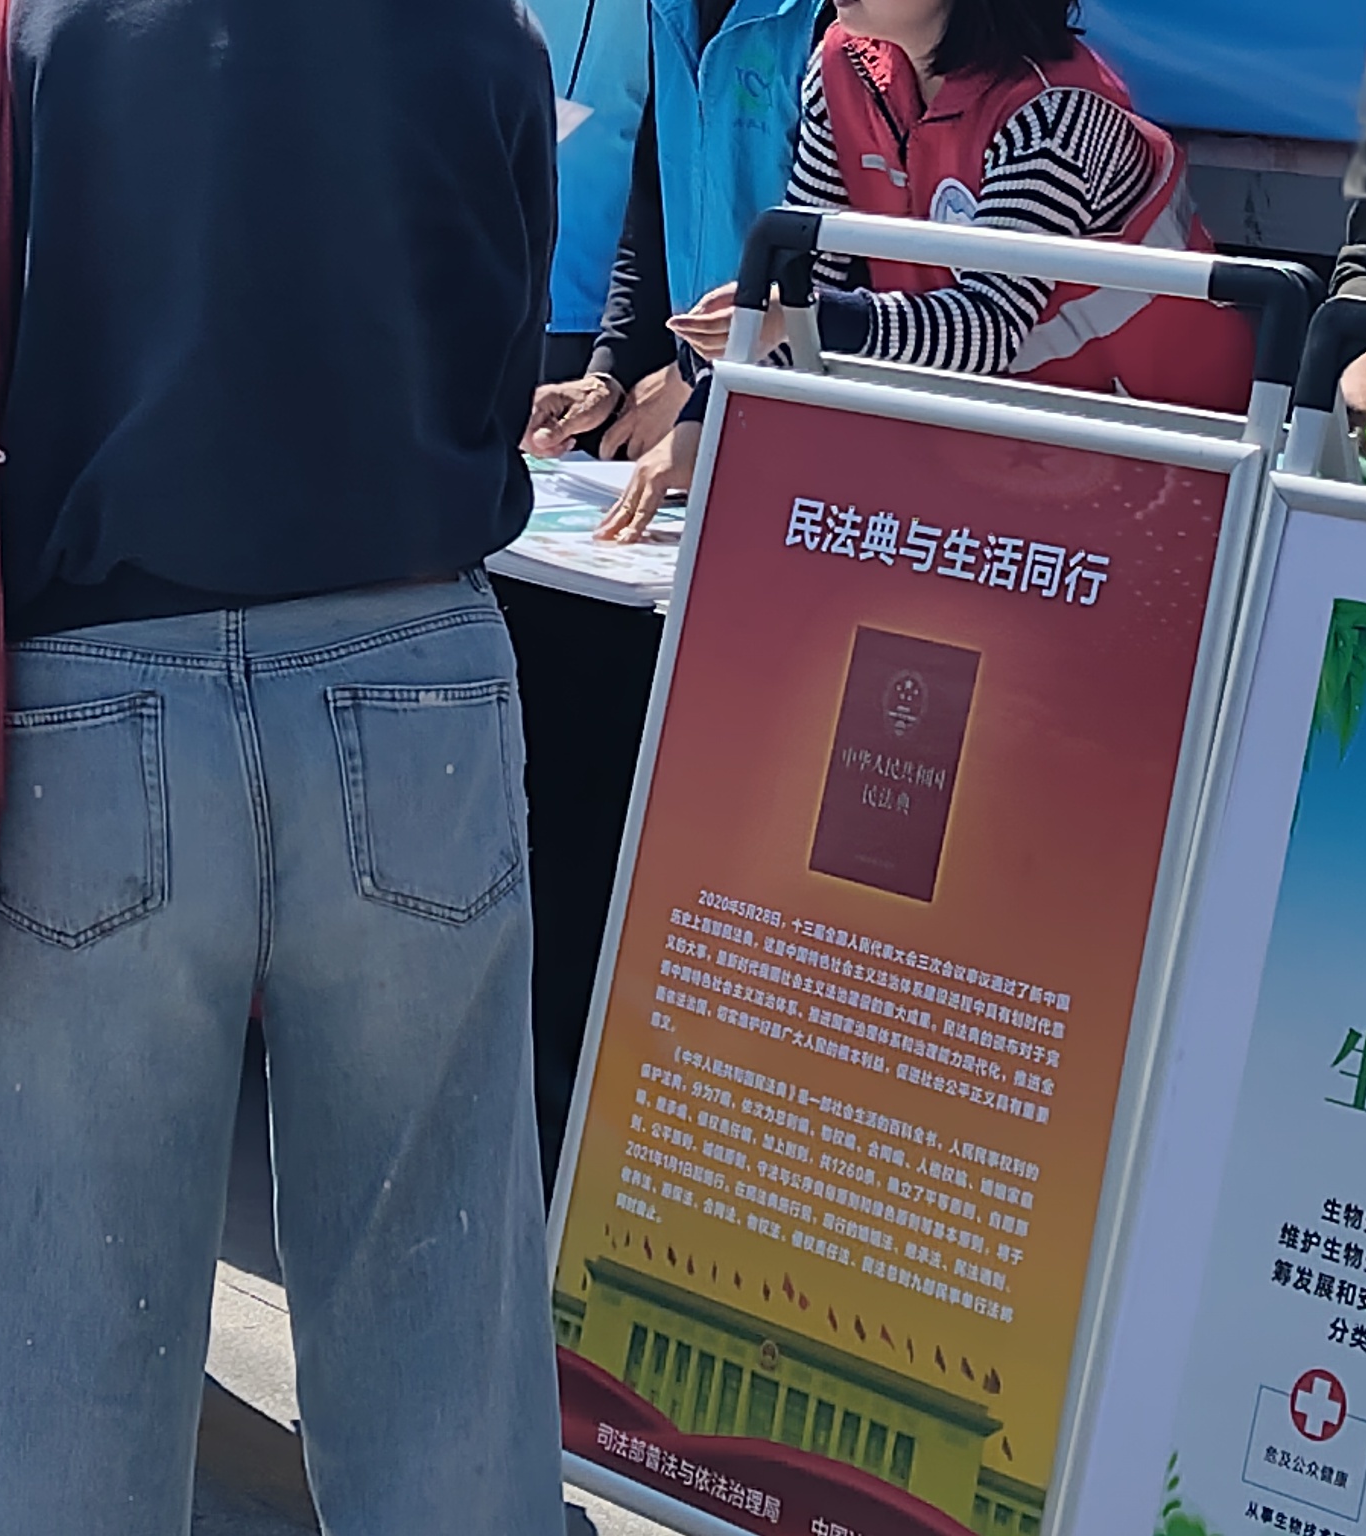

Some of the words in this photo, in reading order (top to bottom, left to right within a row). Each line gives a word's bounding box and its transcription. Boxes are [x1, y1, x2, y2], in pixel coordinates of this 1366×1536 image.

[785, 496, 1111, 606] 民法典与生活同行
[862, 783, 911, 816] 民法典
[597, 1421, 782, 1524] 司法部普法与依法治理局
